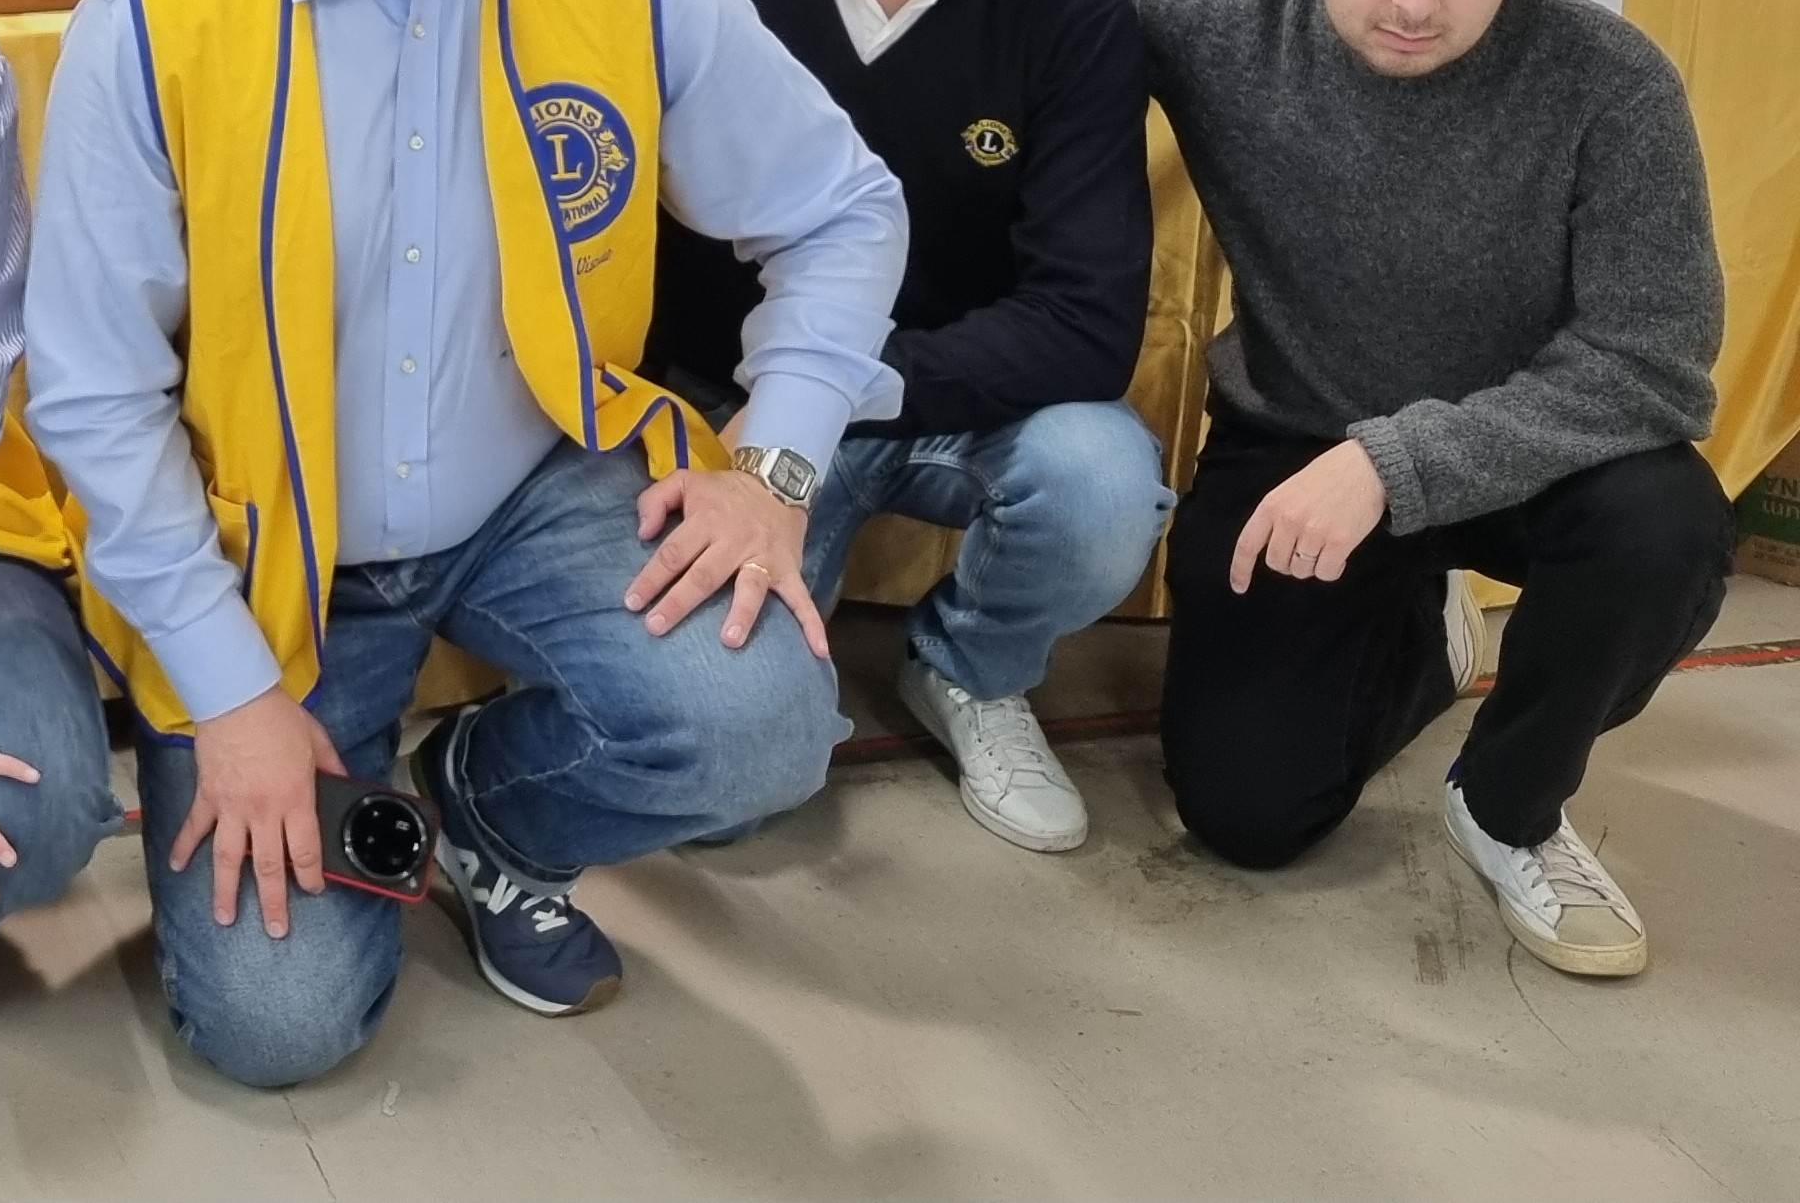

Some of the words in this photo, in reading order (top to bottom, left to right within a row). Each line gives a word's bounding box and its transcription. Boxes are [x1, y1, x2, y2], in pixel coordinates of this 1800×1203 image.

[534, 101, 596, 128] IONS
[981, 132, 997, 152] L
[547, 134, 582, 180] L
[563, 194, 608, 221] ATIONAL
